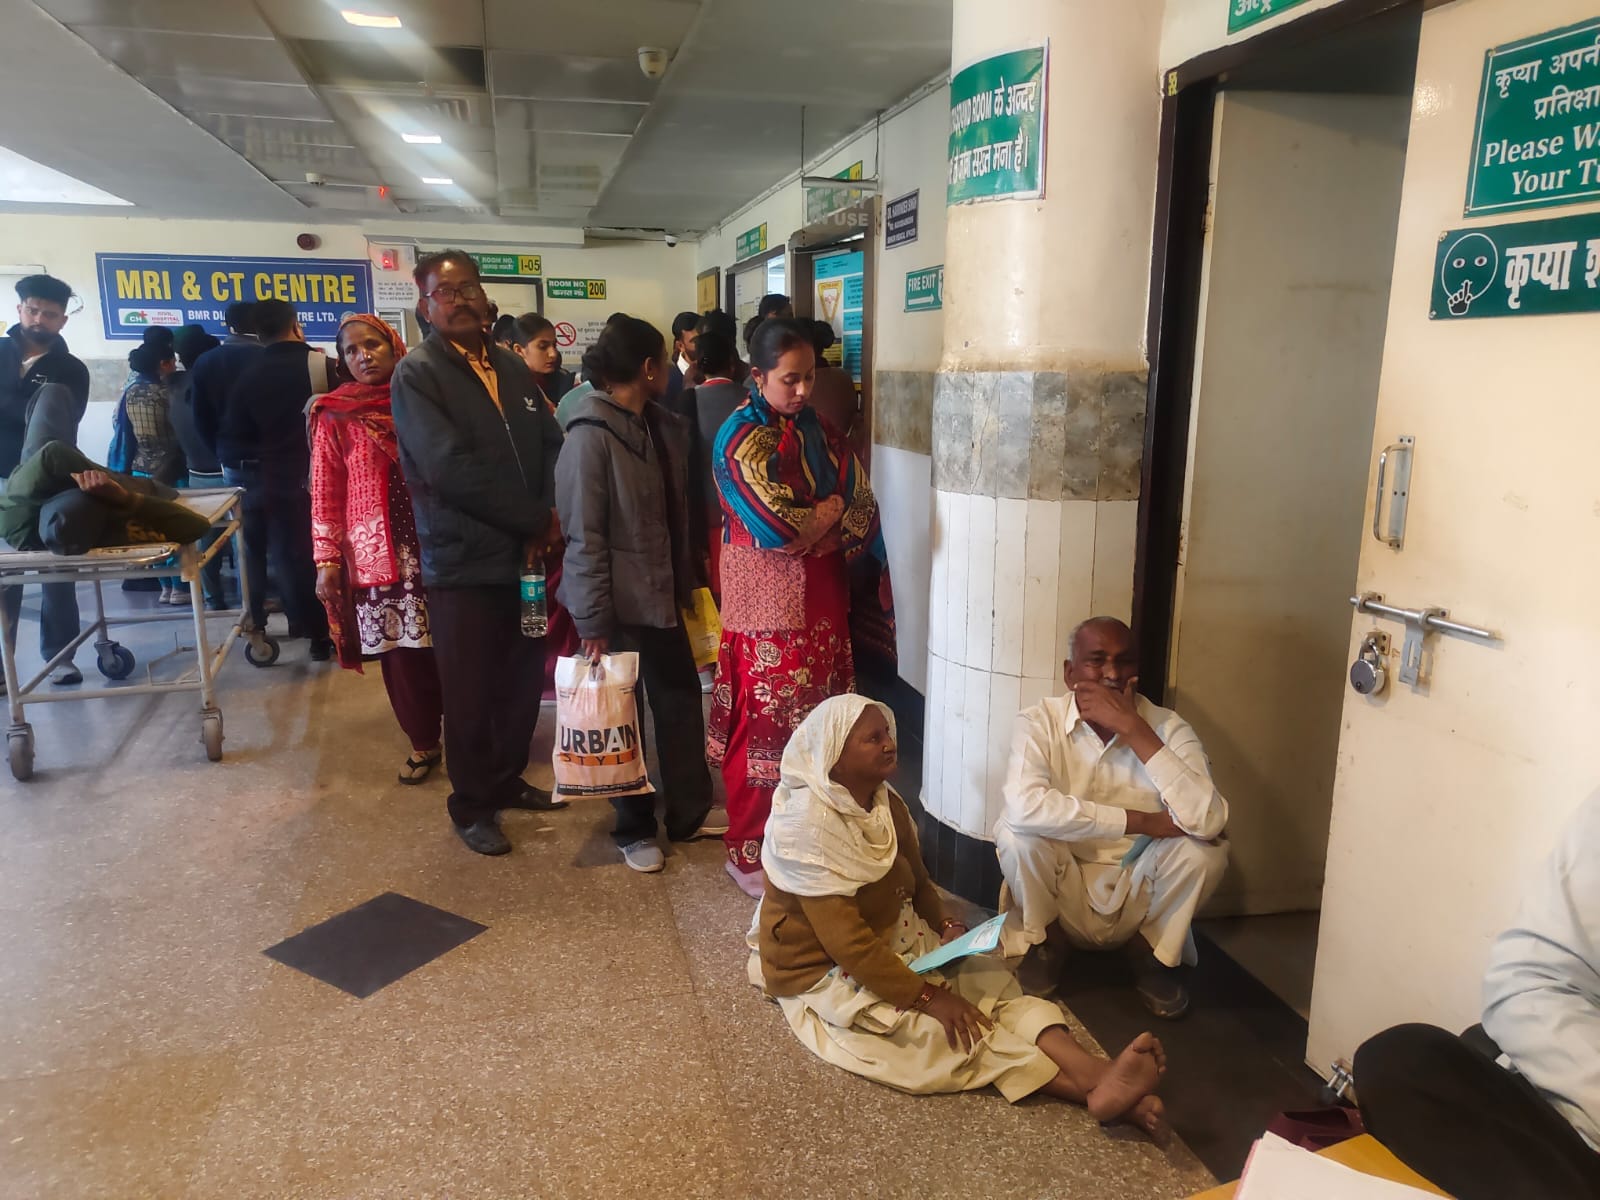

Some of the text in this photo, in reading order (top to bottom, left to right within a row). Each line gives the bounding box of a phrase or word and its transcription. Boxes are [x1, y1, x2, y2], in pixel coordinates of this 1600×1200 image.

[1495, 59, 1542, 98] कृप्या
[973, 90, 992, 121] ROOM
[994, 75, 1005, 118] के
[972, 144, 992, 178] सख्त
[992, 140, 1013, 173] मना
[1483, 135, 1564, 167] Please
[1512, 166, 1571, 195] Your
[834, 212, 870, 227] USE
[482, 256, 501, 264] ROOM
[521, 258, 540, 272] I-05
[1504, 241, 1578, 309] कृप्या
[115, 269, 172, 301] MRI
[182, 271, 202, 302] &
[211, 271, 245, 302] CT
[254, 272, 357, 304] CENTRE
[548, 279, 605, 296] ROOM NO. 200
[908, 277, 921, 293] FIRE
[922, 272, 936, 290] EXIT
[188, 310, 210, 321] BMR
[317, 312, 338, 323] LTD.
[561, 721, 636, 754] URBAN
[560, 748, 637, 767] STYLE
